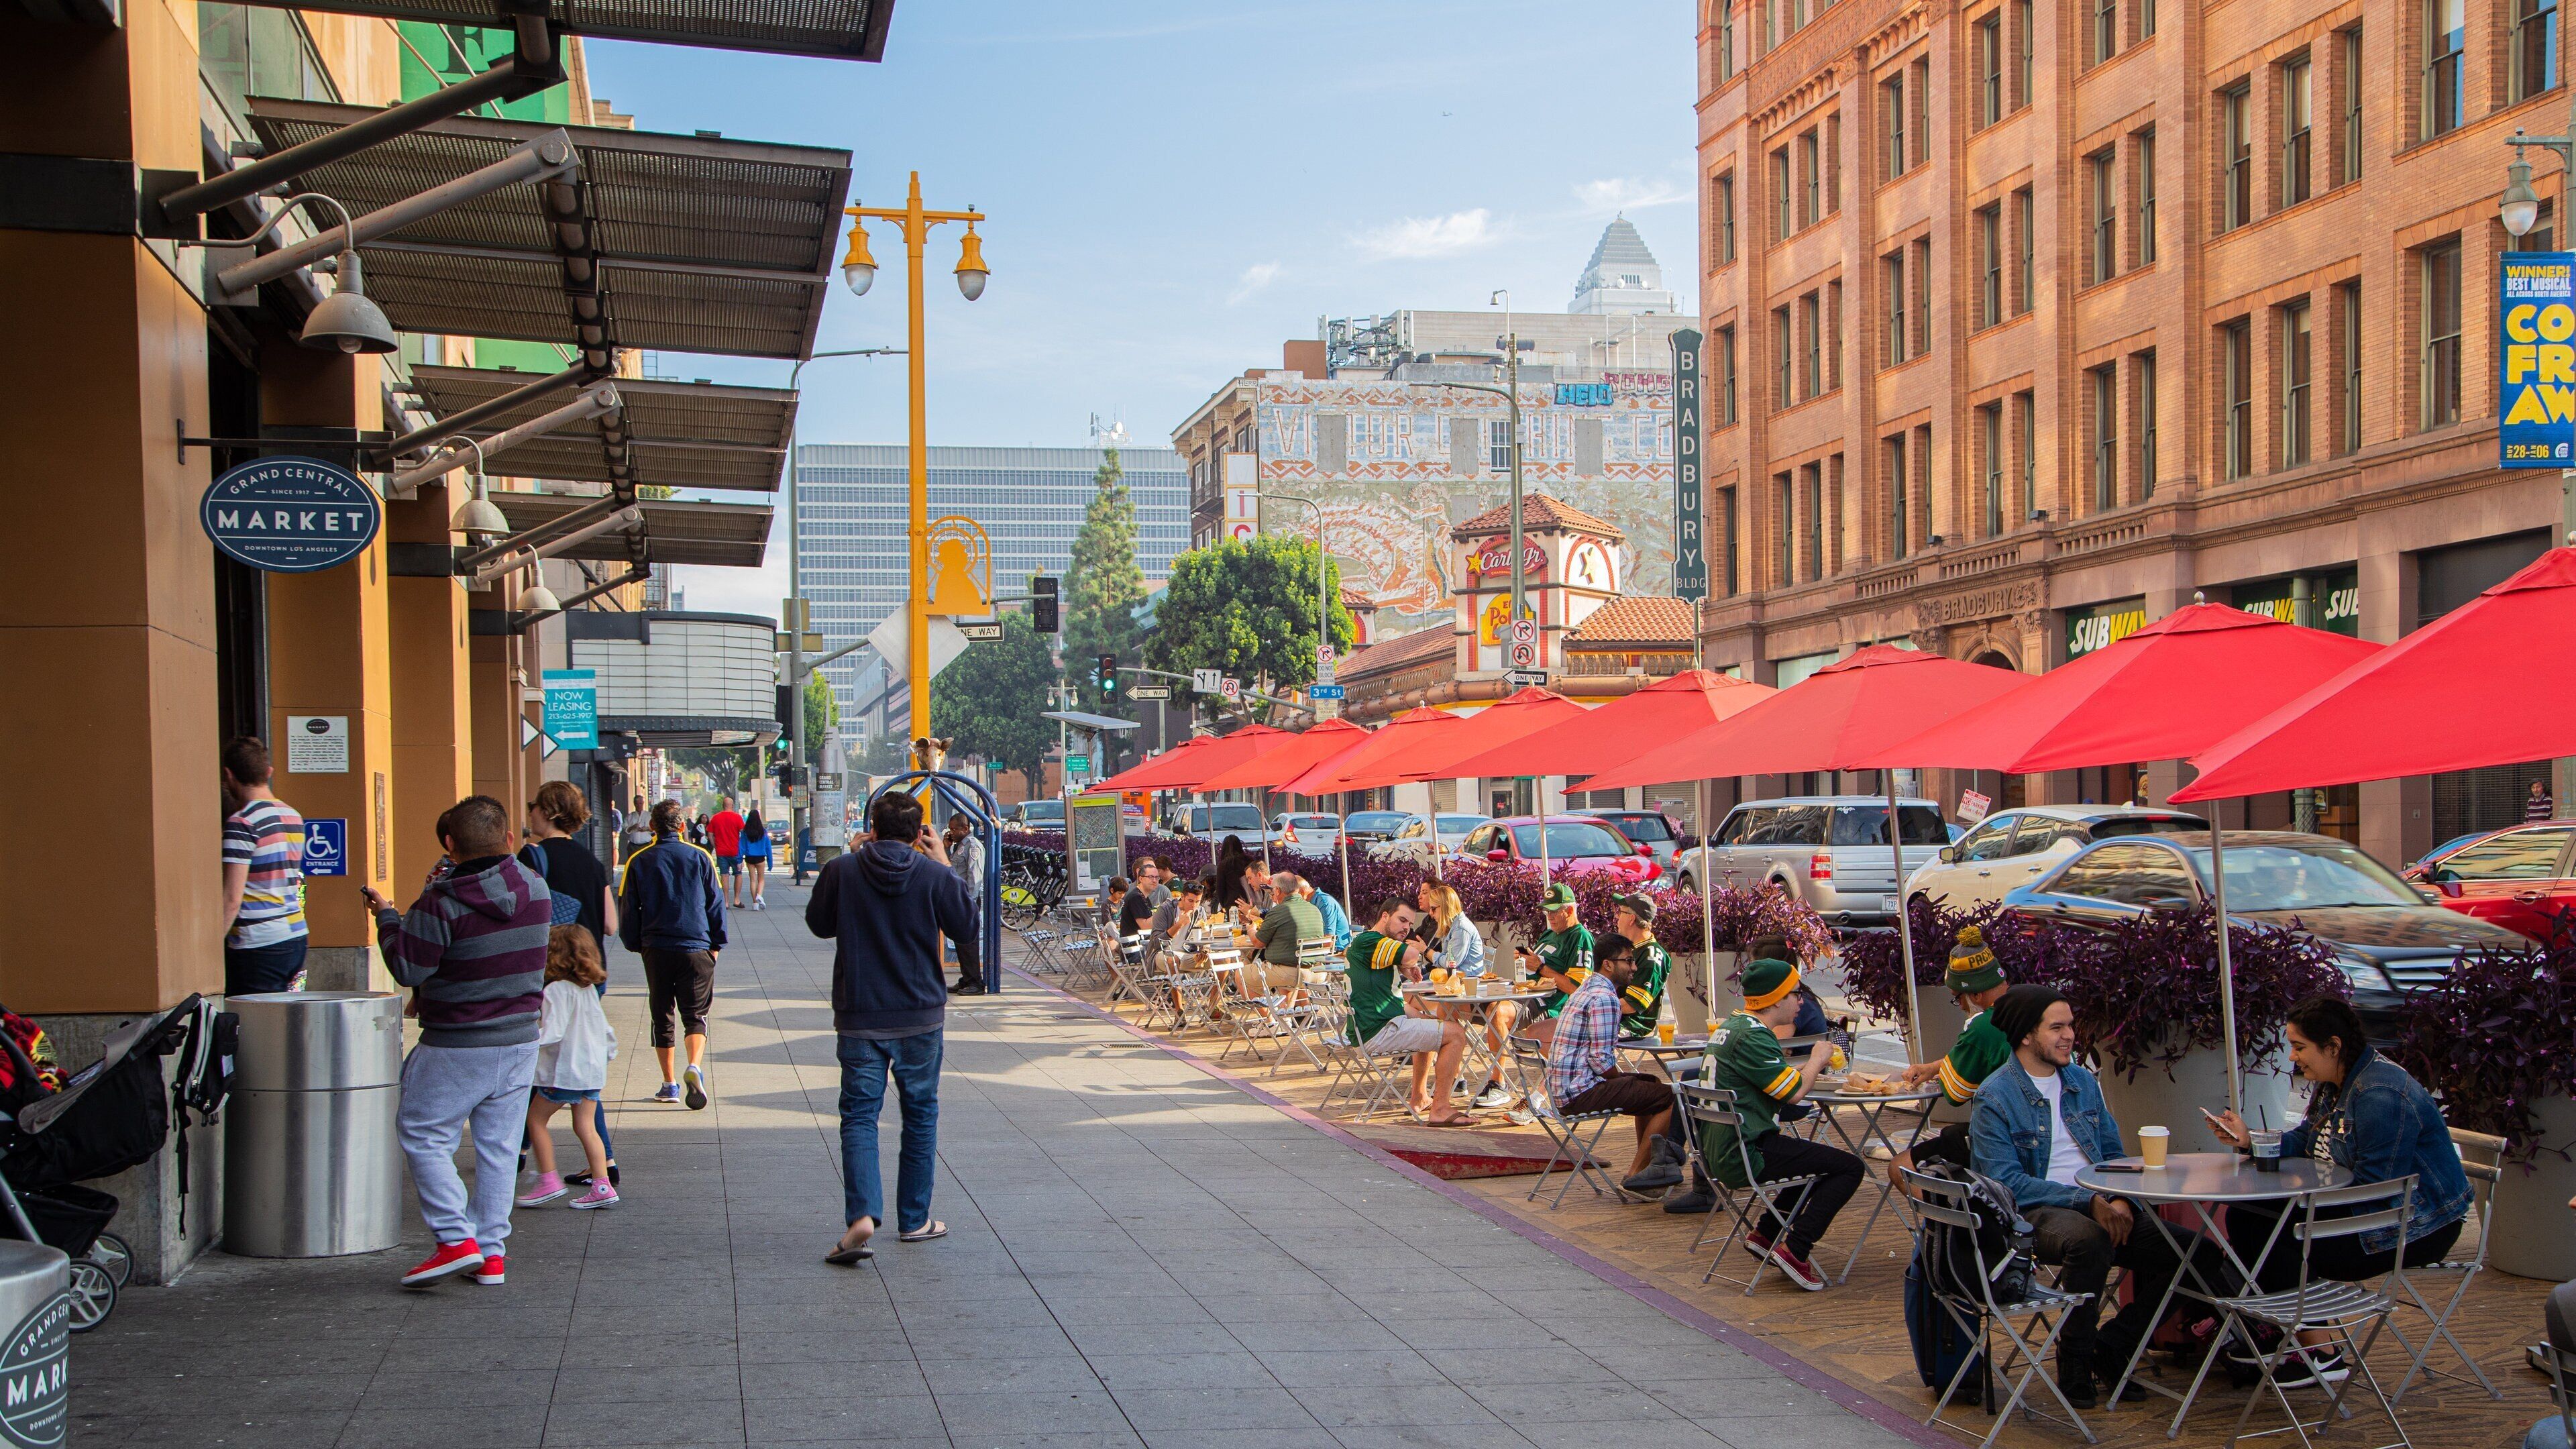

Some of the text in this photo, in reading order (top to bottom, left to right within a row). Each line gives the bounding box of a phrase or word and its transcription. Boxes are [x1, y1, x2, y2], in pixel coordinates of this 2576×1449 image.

[2506, 266, 2571, 278] WINNER!
[2506, 278, 2571, 290] BEST MUSICAL
[2506, 304, 2575, 343] CO
[2507, 344, 2575, 384] FR
[1680, 351, 1697, 568] BRADBURY
[2536, 445, 2549, 458] 06
[229, 468, 351, 497] GRAND CENTRAL
[218, 510, 364, 531] MARKET
[1676, 578, 1706, 589] BLDG
[2244, 598, 2296, 622] SUBWA
[979, 627, 998, 636] WAY
[2069, 609, 2146, 655] SUBWAY
[555, 692, 584, 700] NOW
[1313, 688, 1328, 697] 3rd
[548, 702, 592, 711] LEASING
[1962, 797, 1971, 806] NO
[1576, 950, 1593, 967] 15
[20, 1310, 57, 1357] GRAND
[51, 1334, 62, 1346] SINCE
[7, 1358, 67, 1407] MARK
[30, 1412, 57, 1431] DOWNTOWN
